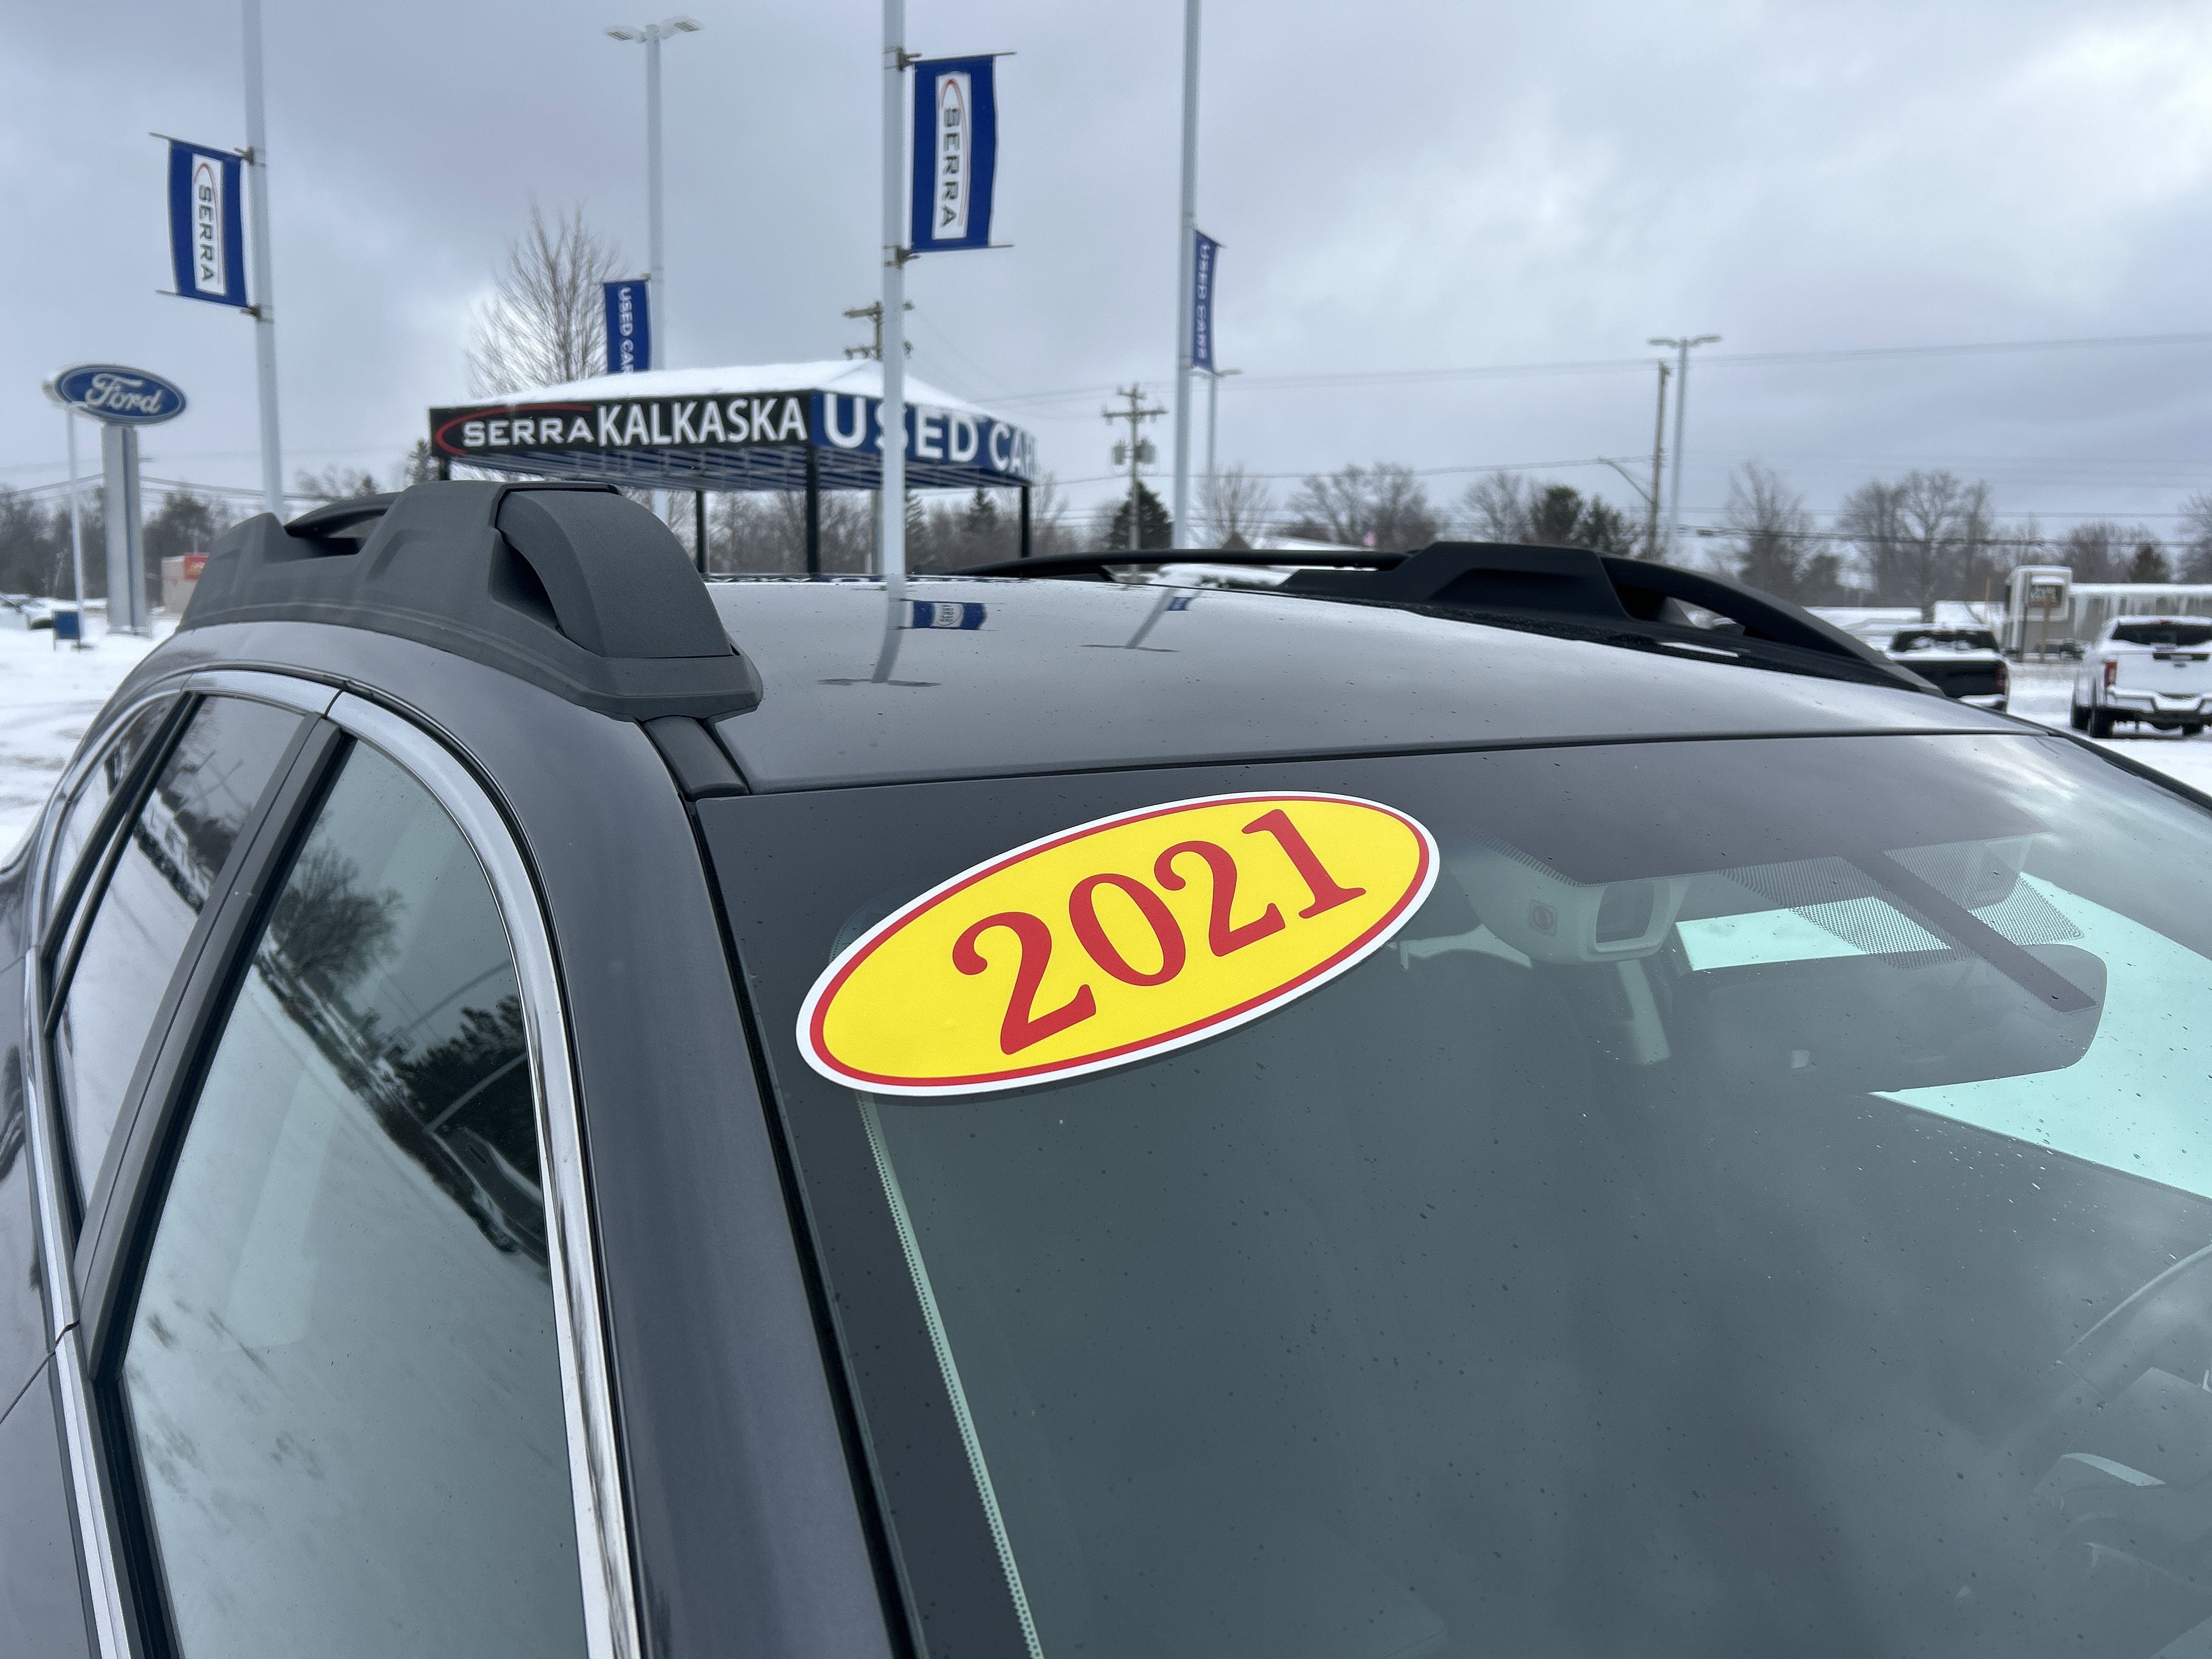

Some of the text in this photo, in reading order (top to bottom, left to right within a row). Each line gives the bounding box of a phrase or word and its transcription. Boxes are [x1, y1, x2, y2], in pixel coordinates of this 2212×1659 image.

[940, 108, 961, 228] SERRA
[198, 184, 214, 281] SERRA
[618, 287, 633, 337] USED
[84, 373, 163, 414] Ford
[462, 397, 808, 447] SERRA KALKASKA
[952, 809, 1367, 1056] 2021
